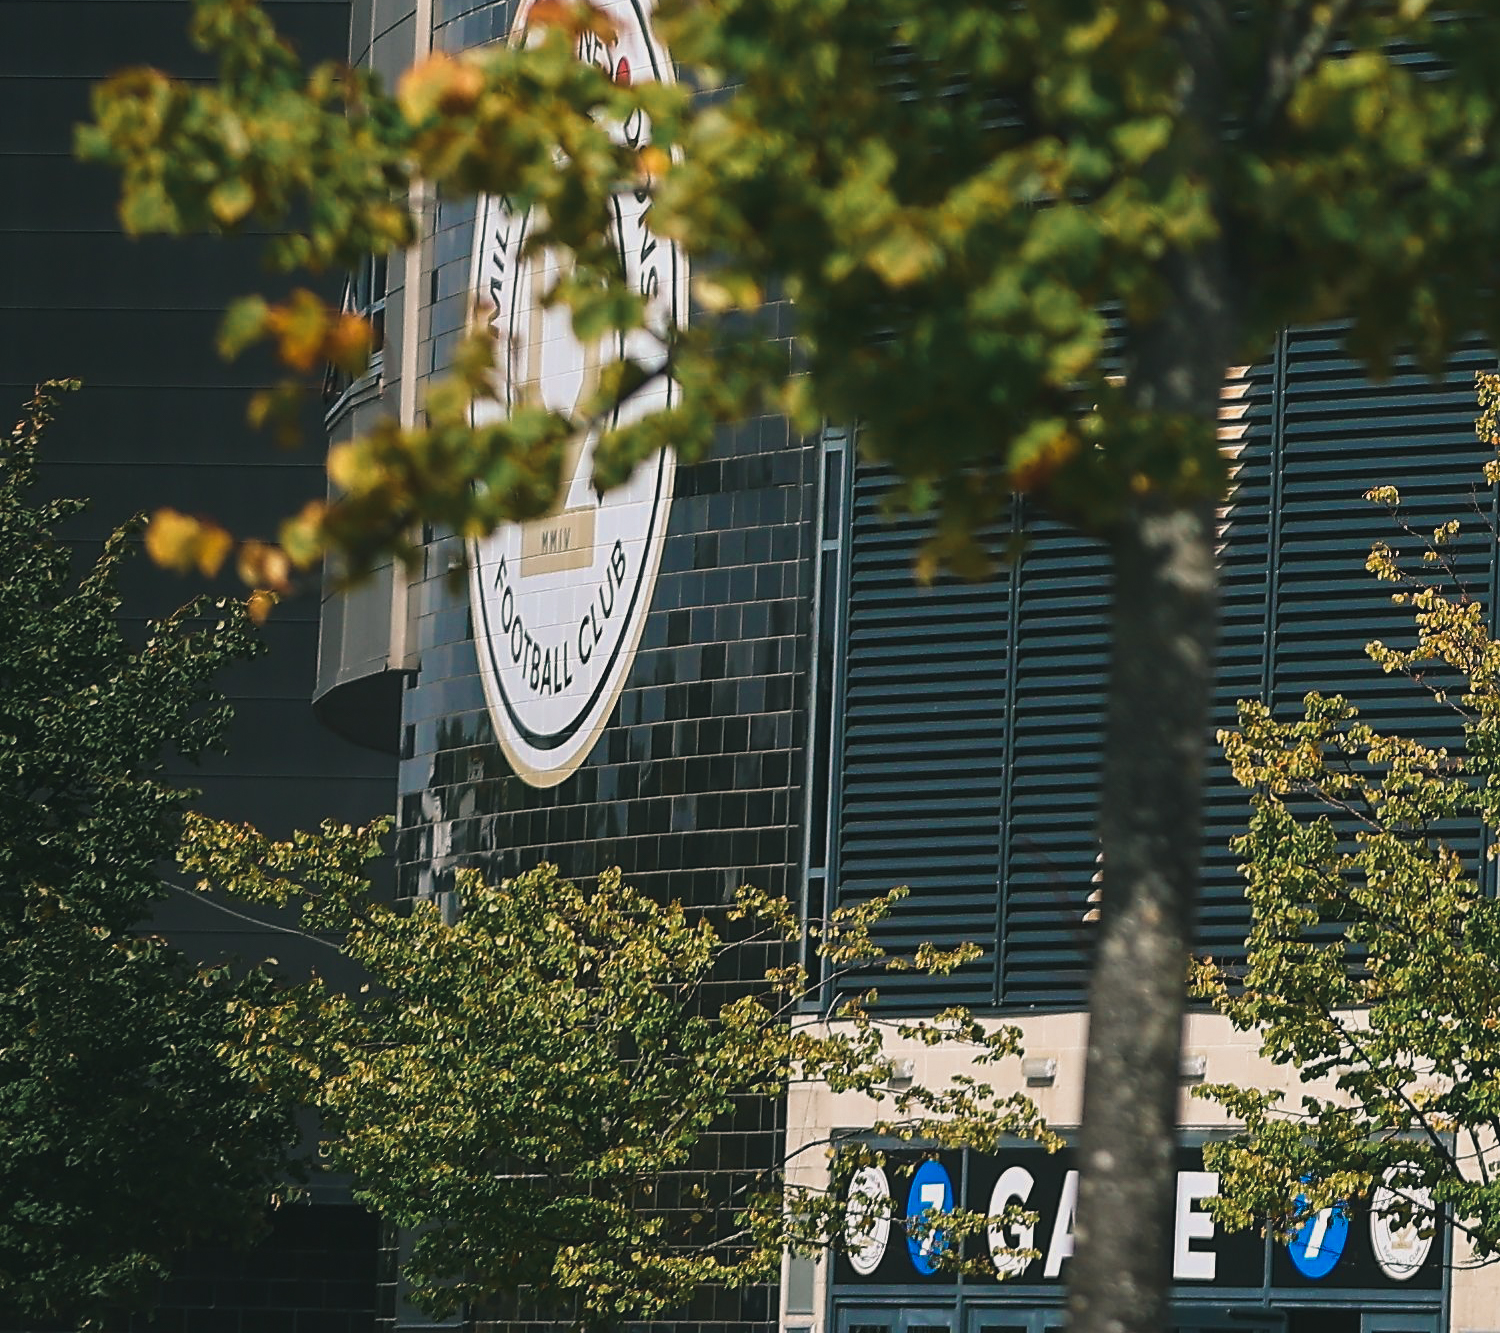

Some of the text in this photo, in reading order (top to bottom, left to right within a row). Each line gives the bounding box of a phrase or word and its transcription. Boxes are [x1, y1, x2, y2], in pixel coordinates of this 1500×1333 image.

[541, 526, 571, 554] MMIV
[494, 539, 626, 696] FOOTBALL CLUB
[987, 1165, 1220, 1280] GAE
